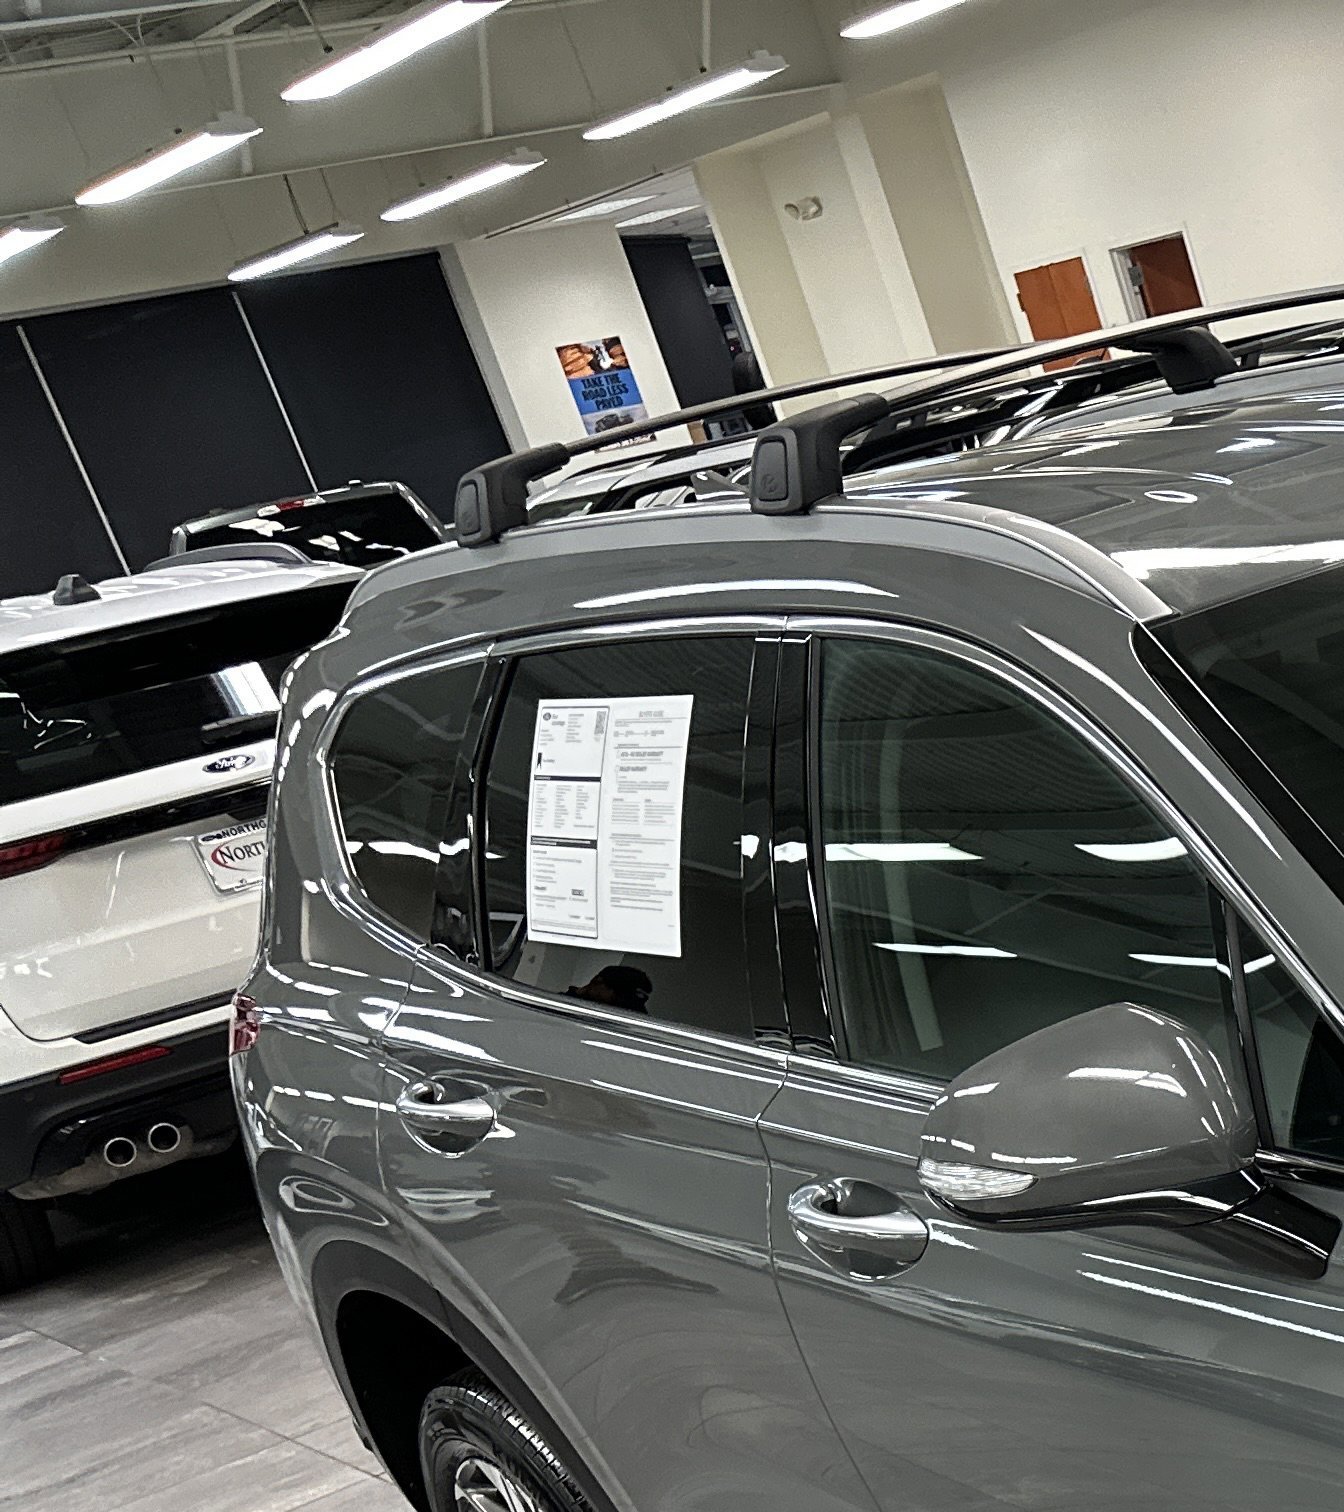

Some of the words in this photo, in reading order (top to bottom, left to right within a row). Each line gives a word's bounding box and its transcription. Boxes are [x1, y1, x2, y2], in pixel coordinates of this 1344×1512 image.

[581, 376, 605, 389] TAKE
[604, 373, 622, 386] THE
[606, 383, 629, 396] LESS
